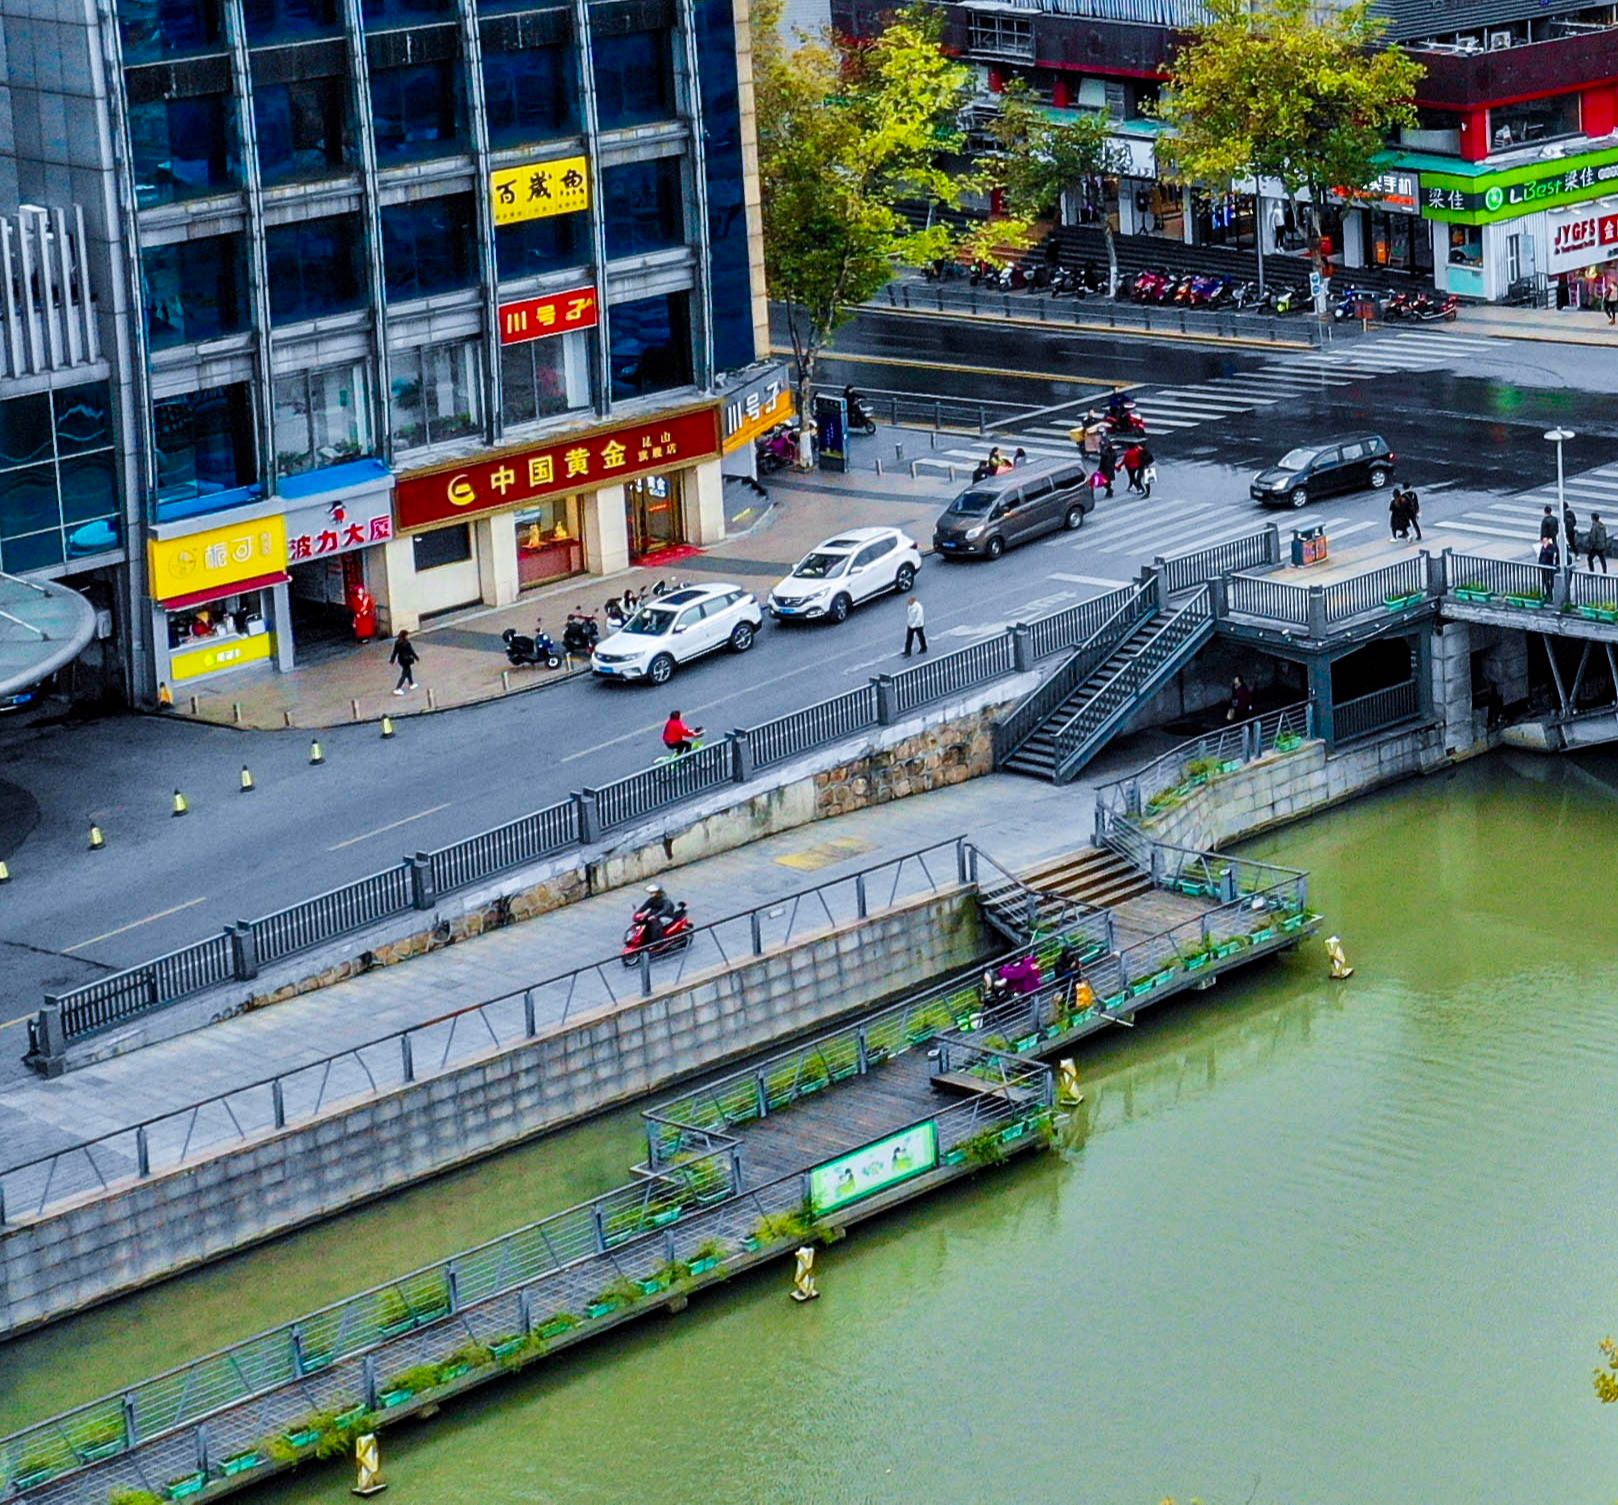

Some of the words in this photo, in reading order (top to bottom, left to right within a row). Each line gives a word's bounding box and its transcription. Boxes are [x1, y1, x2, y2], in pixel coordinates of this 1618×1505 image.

[1564, 165, 1596, 193] 梁佳
[1428, 188, 1465, 211] 梁佳
[1554, 218, 1596, 247] JYGFS
[506, 297, 594, 335] 川号子
[727, 380, 780, 435] 川号子
[489, 439, 627, 497] 中国黄金
[287, 515, 394, 561] 波力大厦
